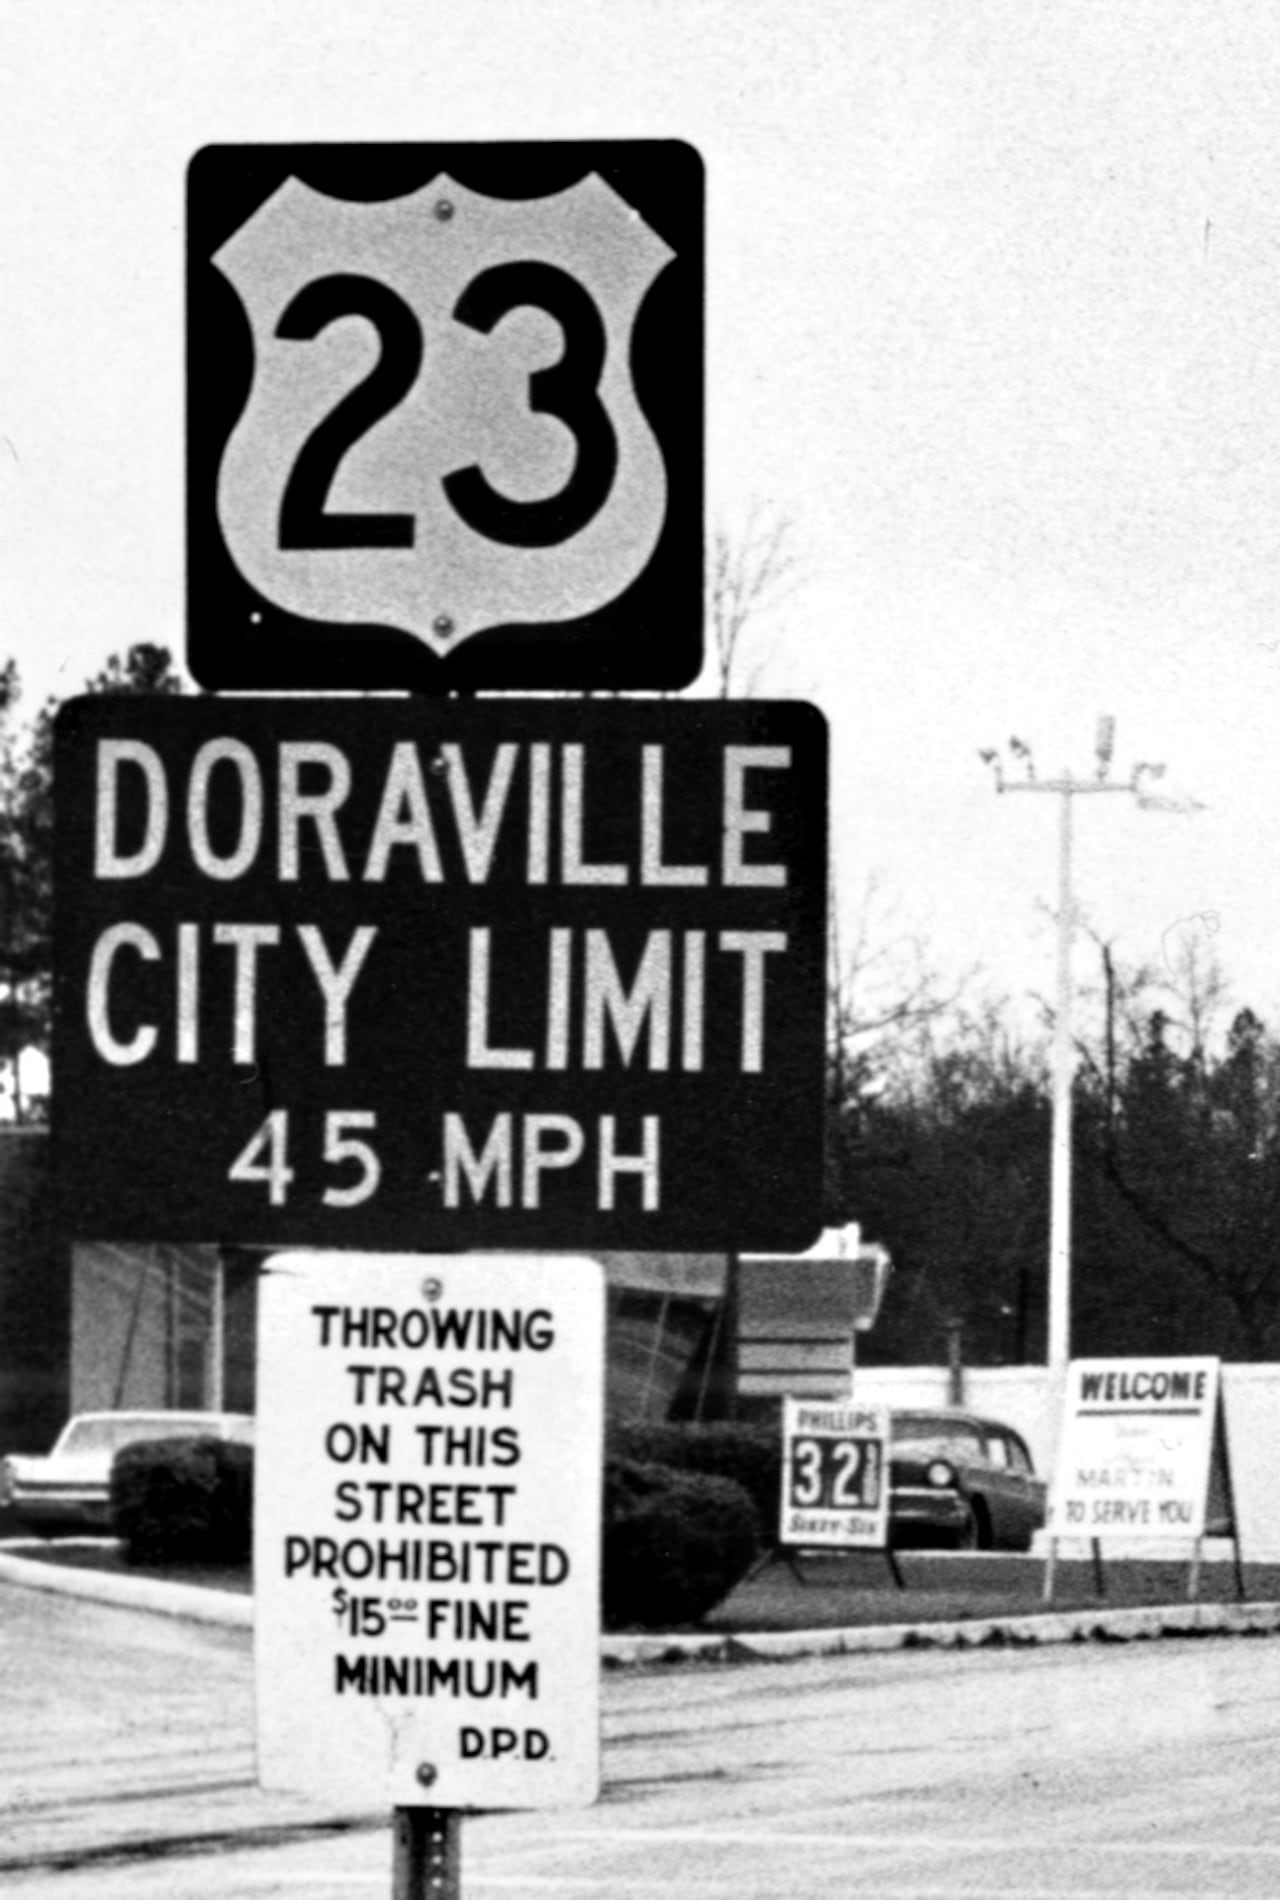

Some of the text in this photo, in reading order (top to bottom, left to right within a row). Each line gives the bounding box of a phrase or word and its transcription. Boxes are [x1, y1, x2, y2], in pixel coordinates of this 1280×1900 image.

[272, 260, 619, 551] 23
[94, 737, 790, 887] DORAVILLE
[87, 922, 787, 1073] CITY LIMIT
[228, 1110, 659, 1211] 45 MPH
[311, 1305, 555, 1352] THROWING
[346, 1364, 513, 1409] TRASH
[1081, 1371, 1206, 1402] WELCOME
[797, 1409, 878, 1433] PHILLIPS
[325, 1422, 521, 1468] ON THIS
[335, 1480, 517, 1526] STREET
[1065, 1499, 1191, 1525] TO SERVE YOU
[284, 1535, 570, 1587] PROHIBITED
[427, 1598, 530, 1643] FINE
[335, 1654, 539, 1700] MINIMUM
[459, 1726, 556, 1761] D.P.D.
